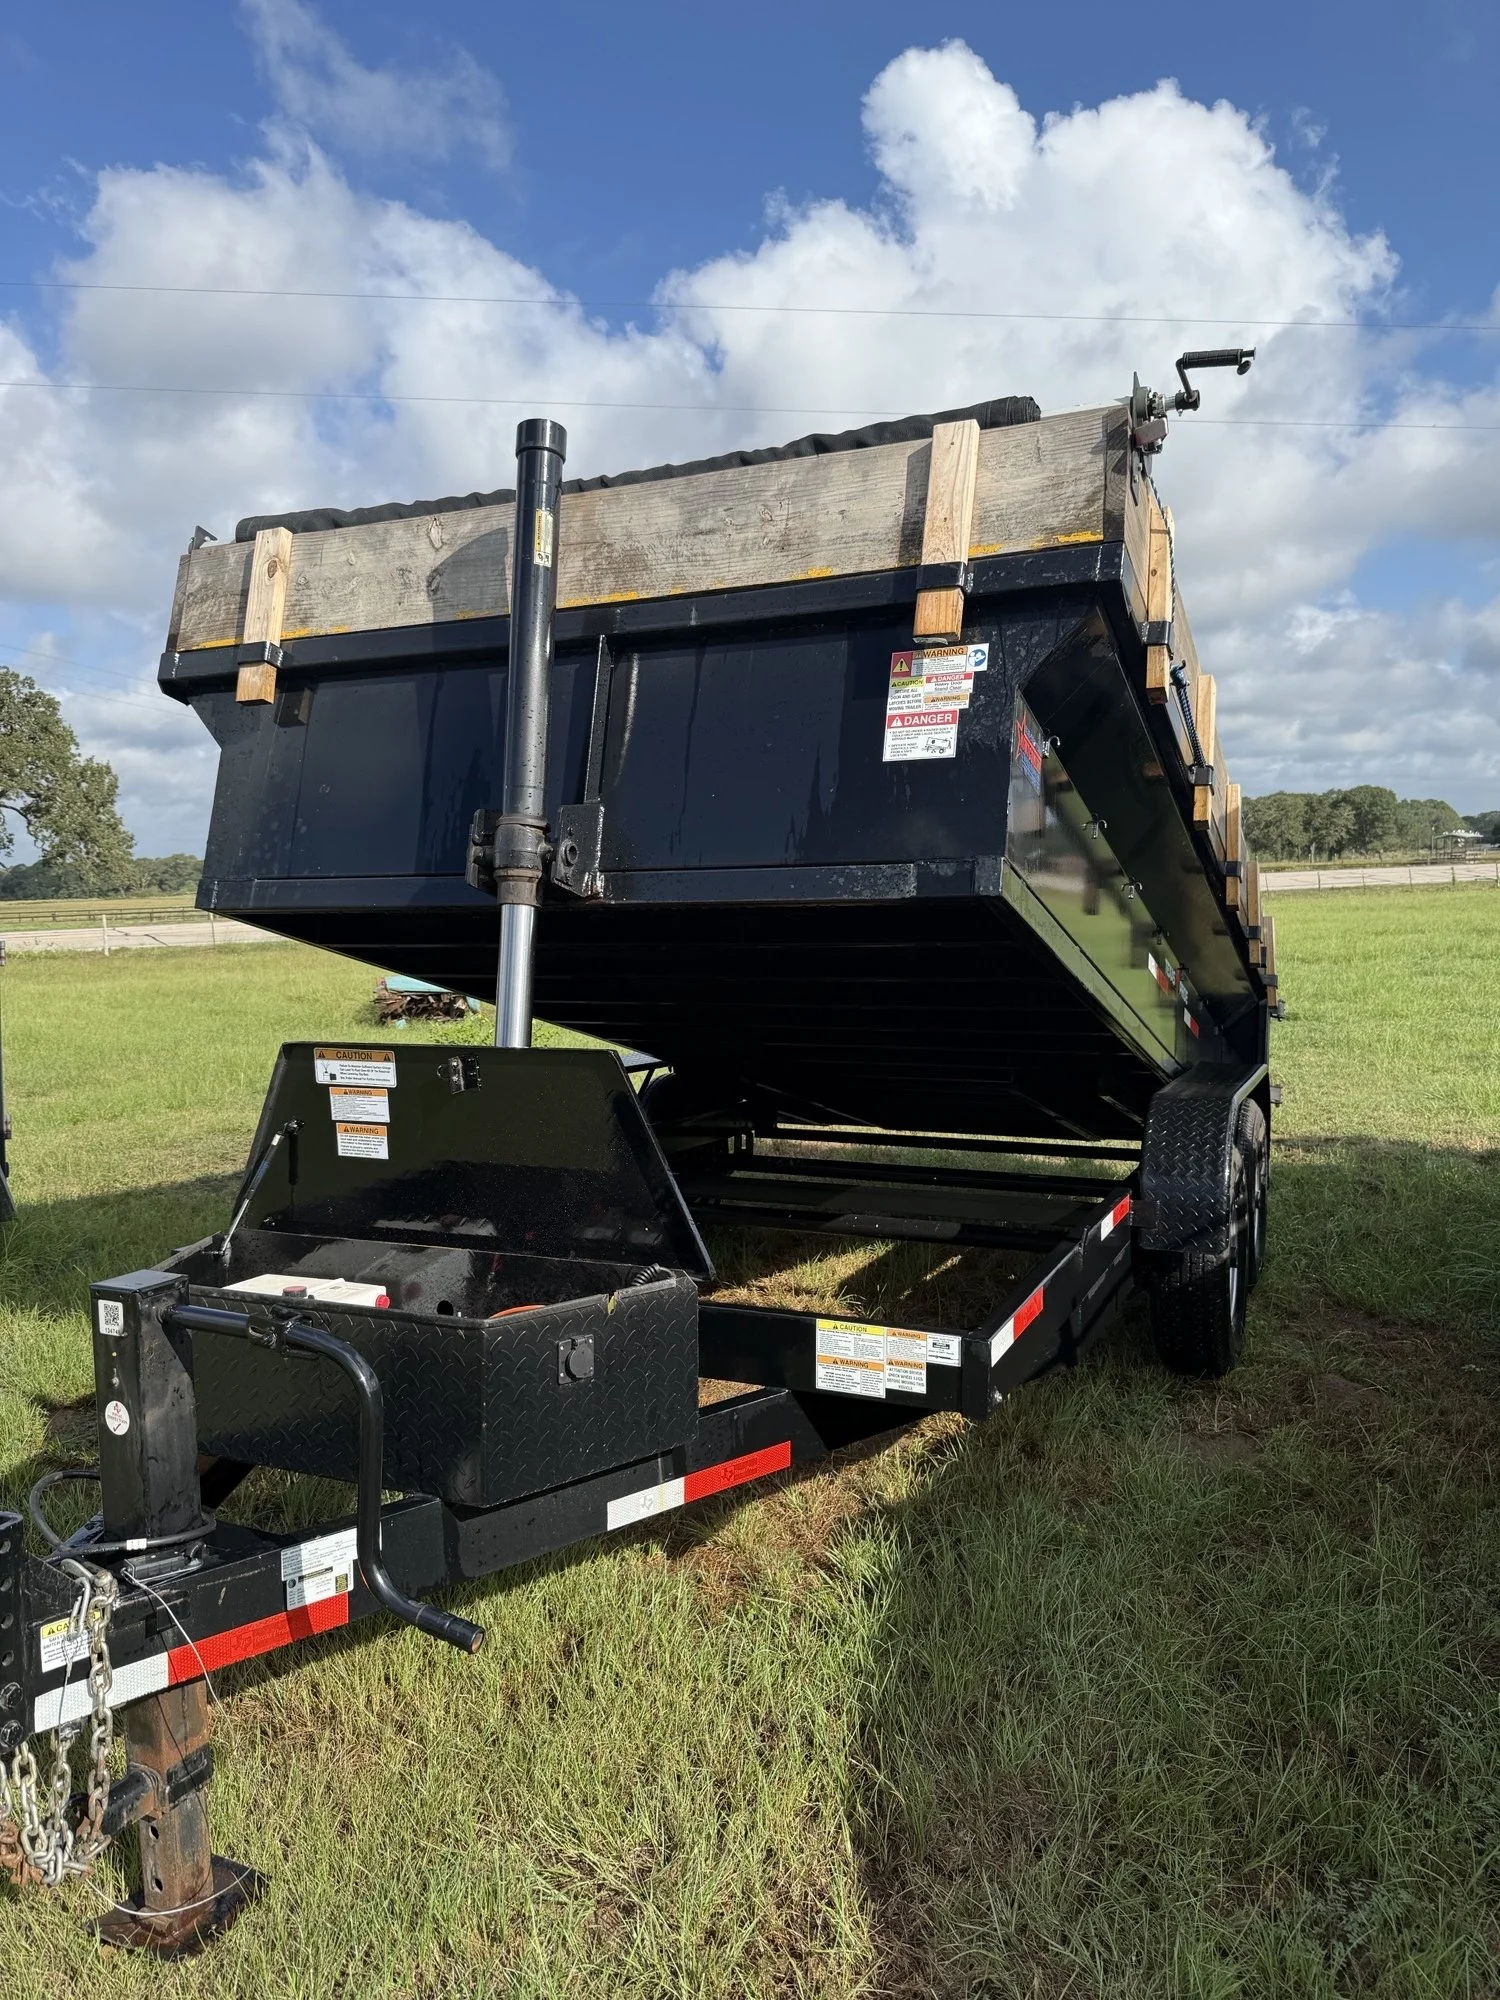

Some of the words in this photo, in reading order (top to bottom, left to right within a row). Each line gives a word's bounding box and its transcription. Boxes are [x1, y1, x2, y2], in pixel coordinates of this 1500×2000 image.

[924, 647, 964, 658] WARNING
[937, 674, 964, 682] DANGER
[897, 679, 923, 687] CAUTION
[904, 714, 953, 726] DANGER
[336, 1051, 373, 1060] CAUTION
[349, 1127, 379, 1135] WARNING
[840, 1324, 868, 1333] CAUTION
[897, 1331, 921, 1339] WARNING
[839, 1359, 869, 1369] WARNING
[894, 1360, 923, 1369] WARNING
